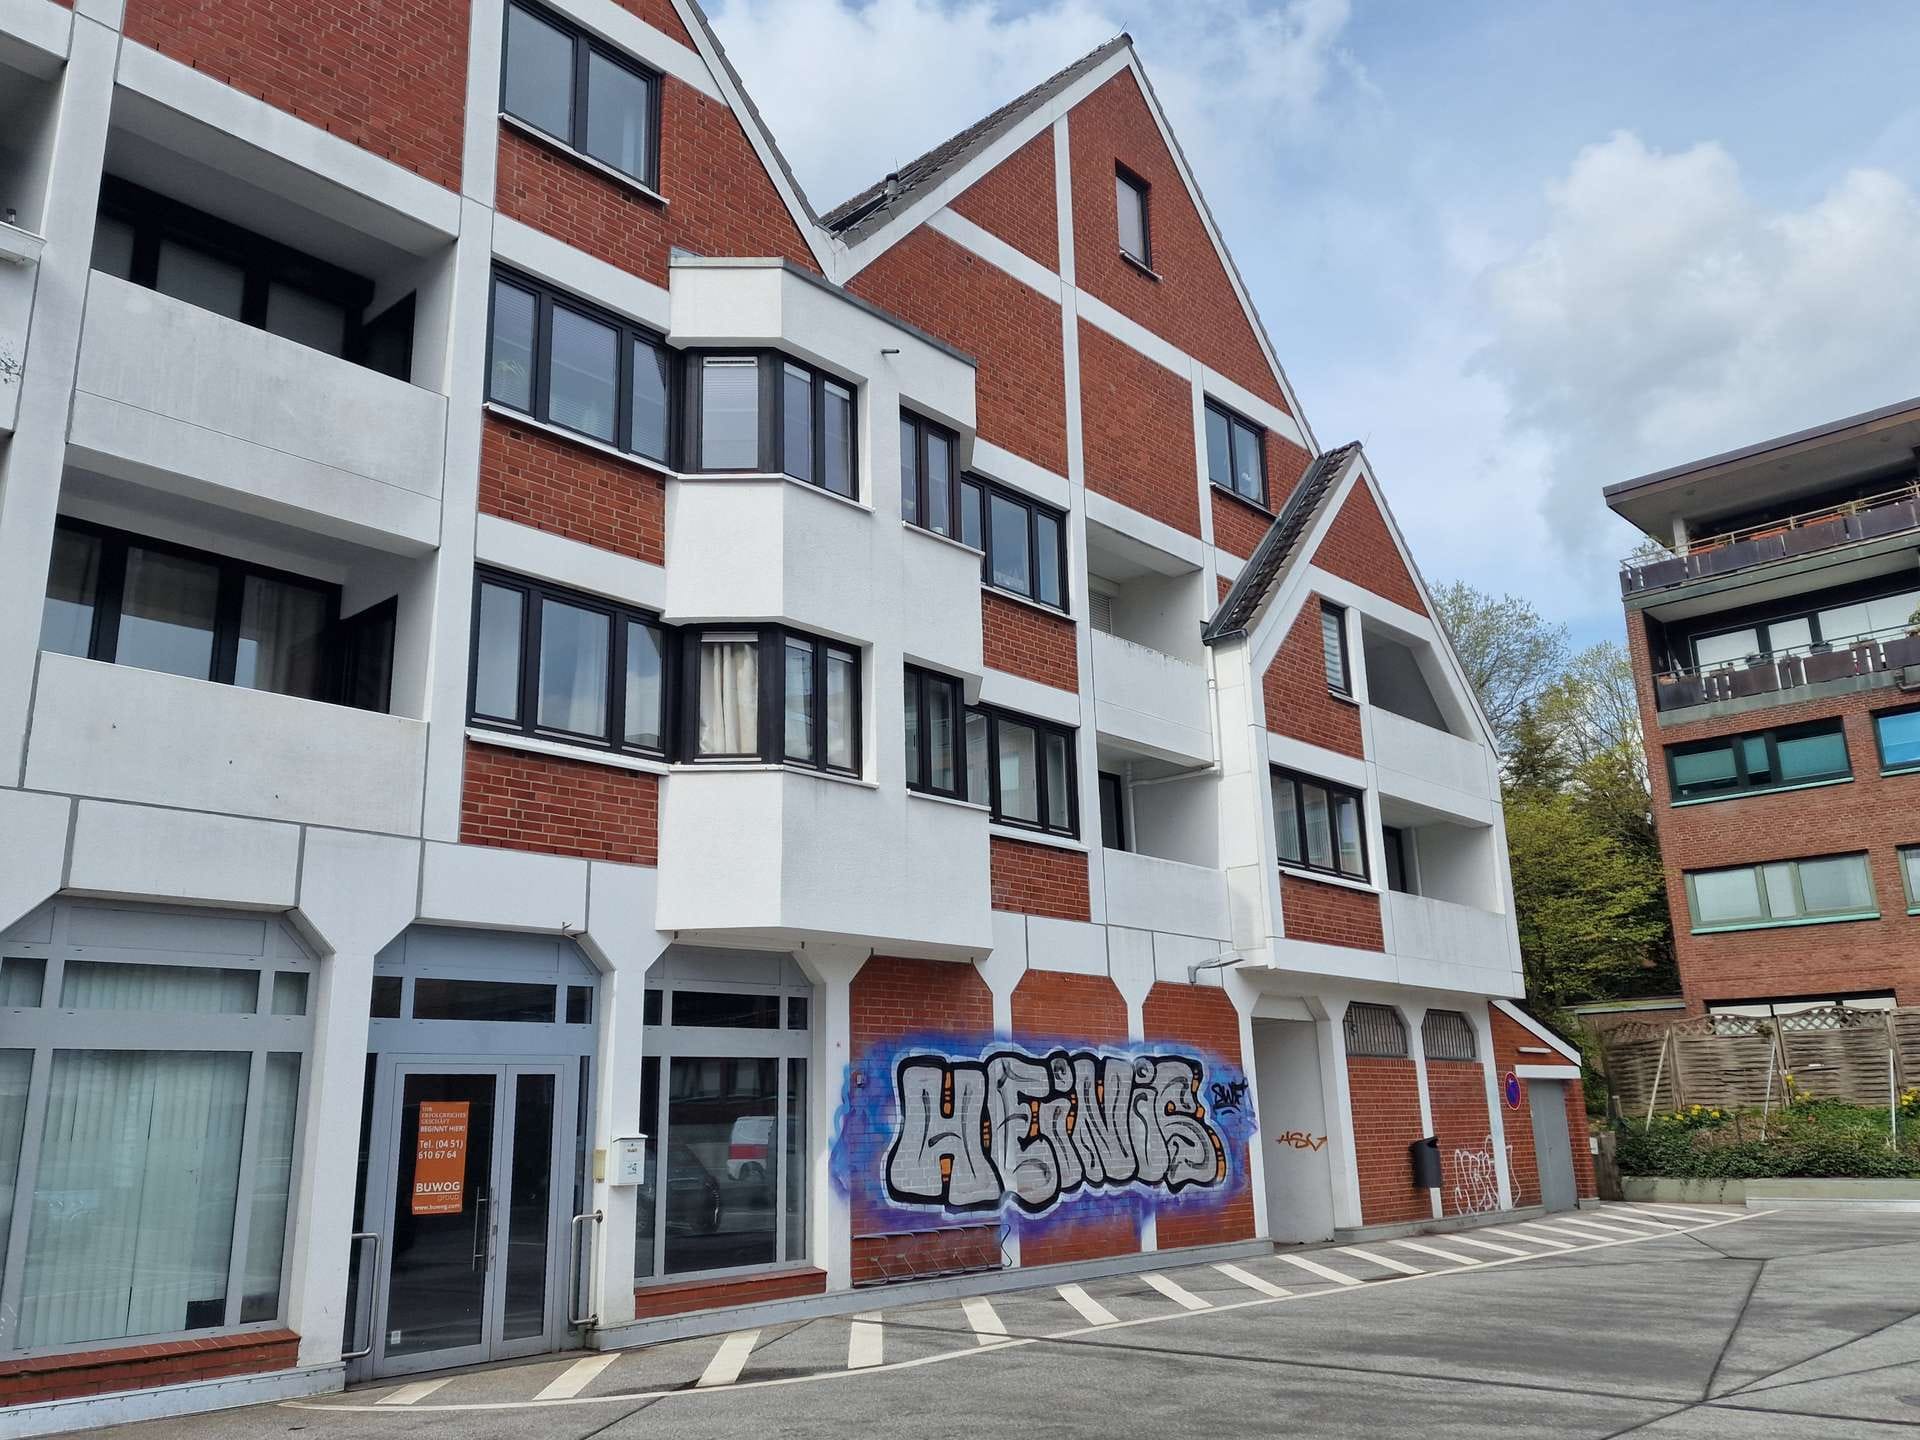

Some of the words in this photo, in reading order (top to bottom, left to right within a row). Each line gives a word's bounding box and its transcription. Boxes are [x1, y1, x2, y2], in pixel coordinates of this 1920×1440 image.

[420, 1125, 448, 1133] BEGINNT
[419, 1140, 434, 1149] Tel.
[435, 1140, 449, 1149] (04
[450, 1139, 464, 1149] 51)
[418, 1151, 433, 1160] 610
[433, 1151, 445, 1160] 67
[446, 1150, 457, 1159] 64
[416, 1181, 461, 1193] BUWOG
